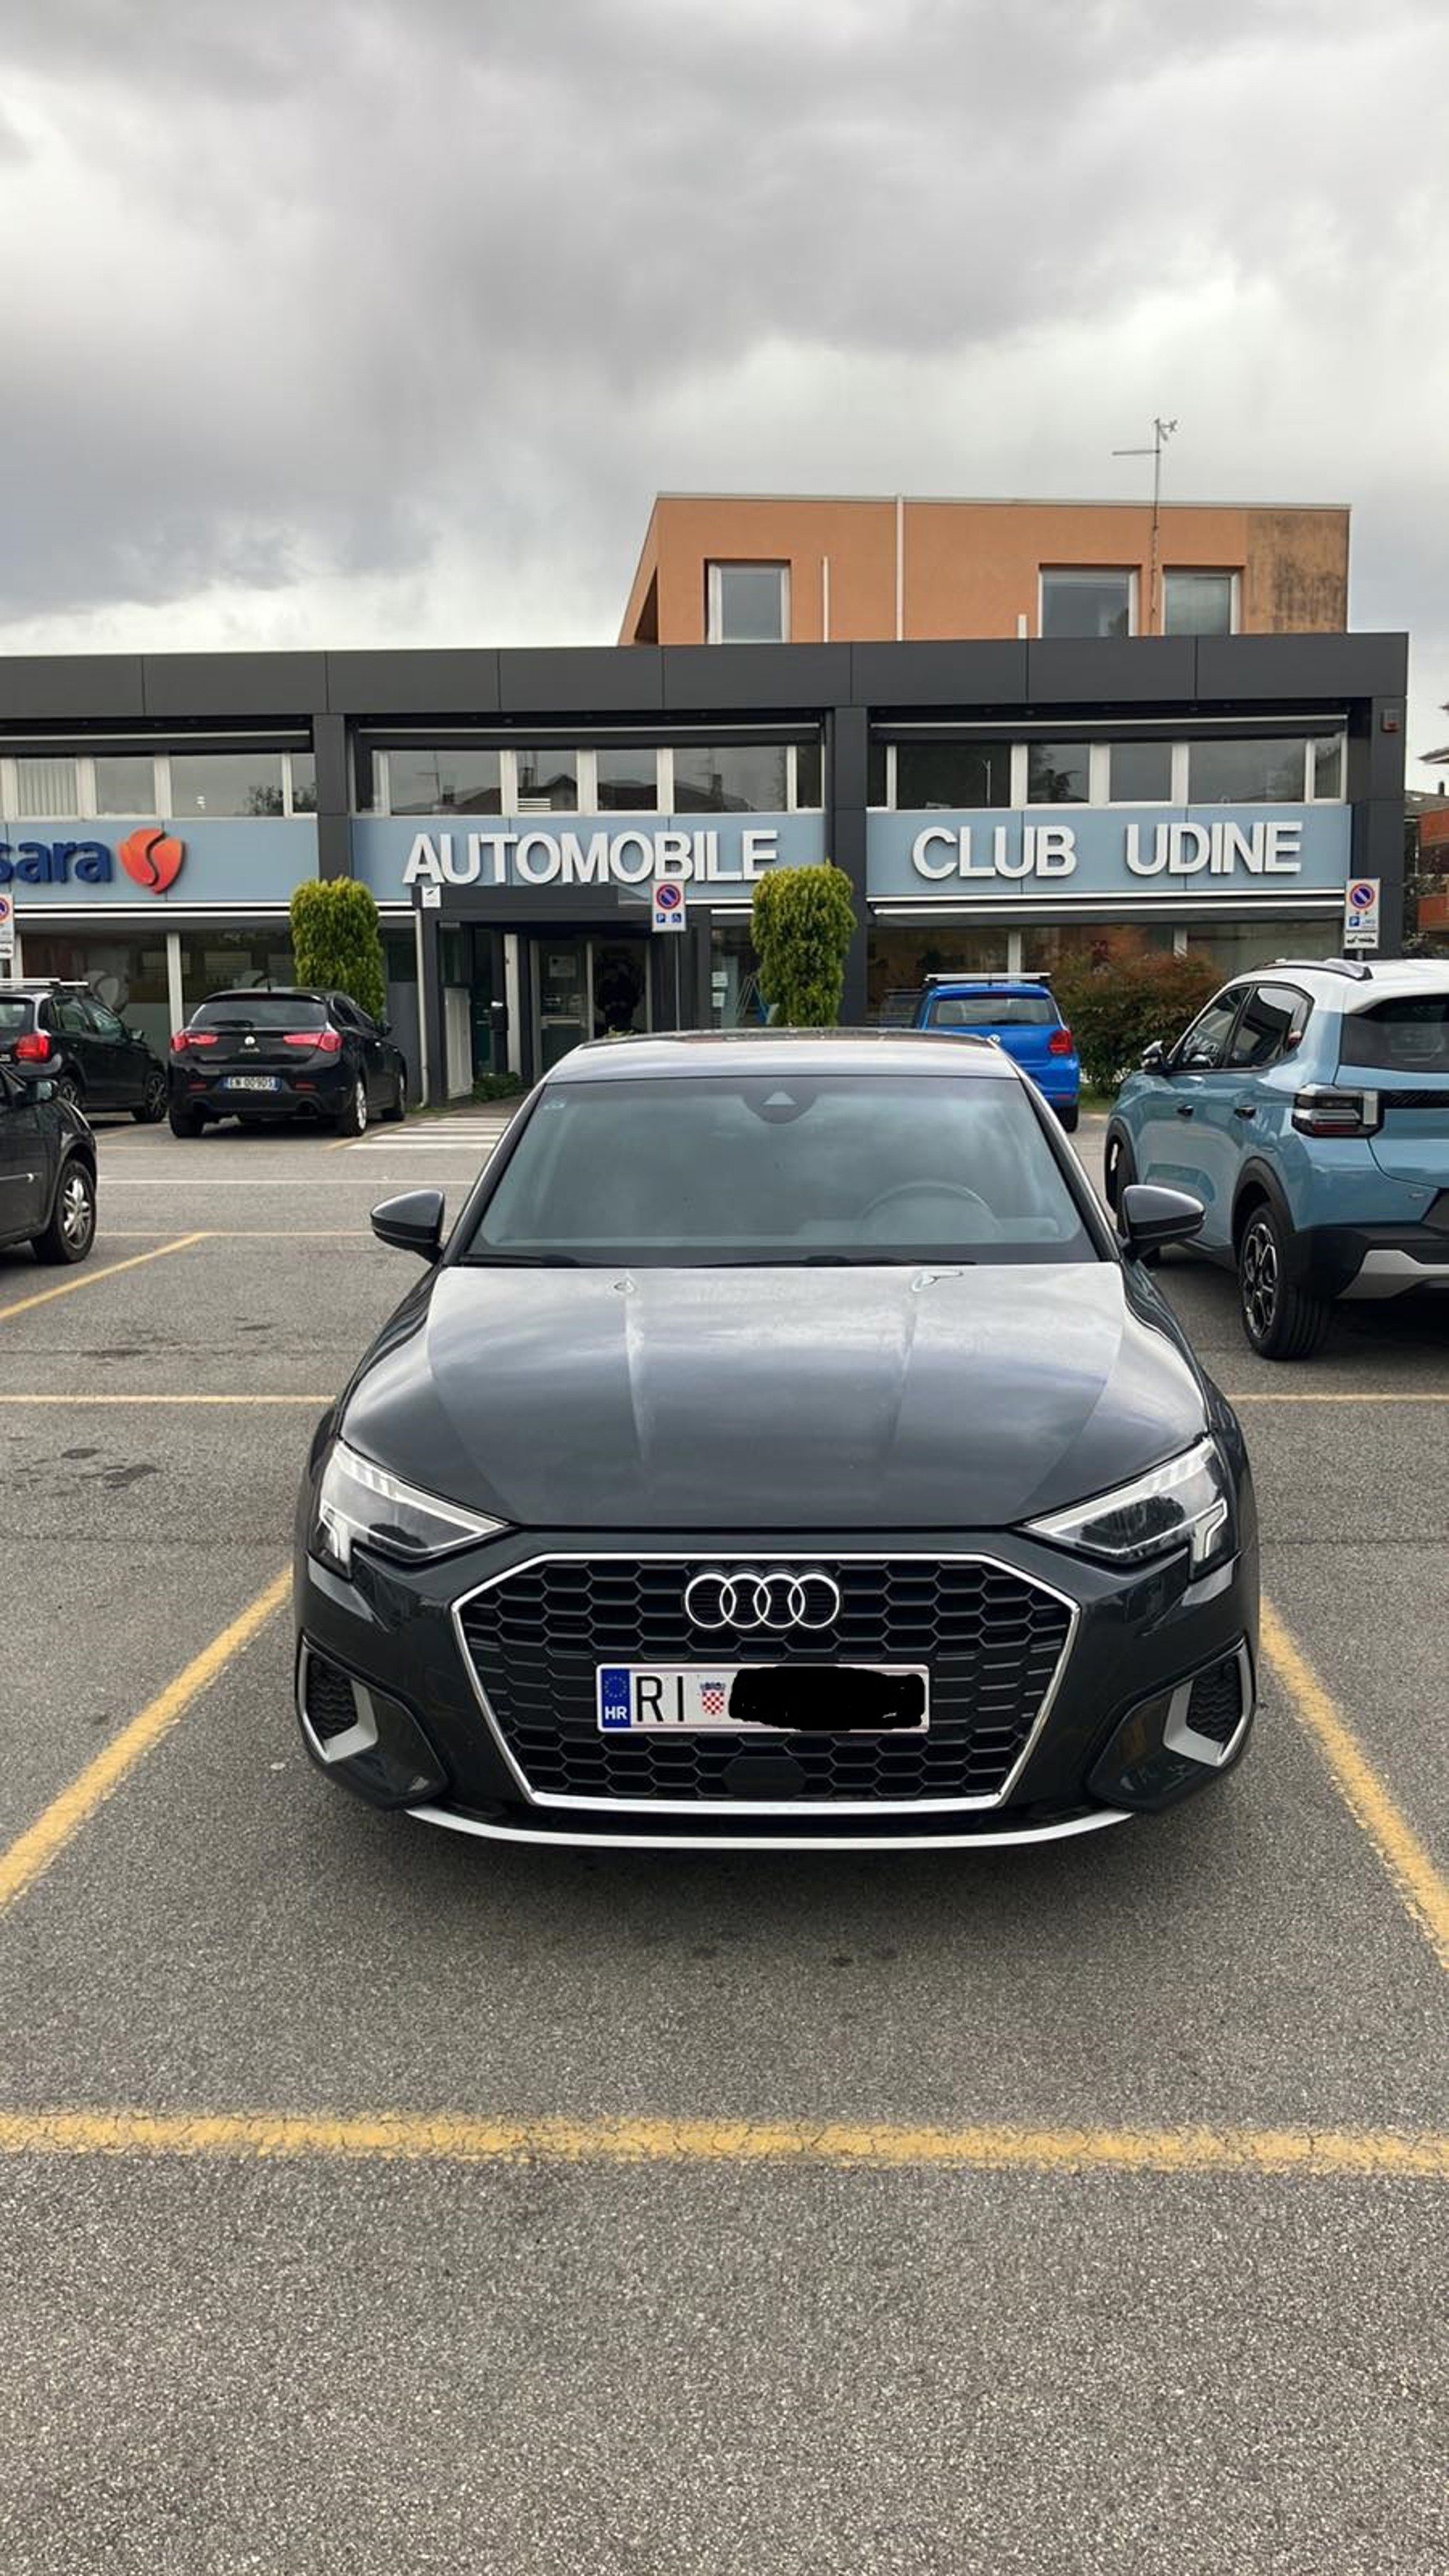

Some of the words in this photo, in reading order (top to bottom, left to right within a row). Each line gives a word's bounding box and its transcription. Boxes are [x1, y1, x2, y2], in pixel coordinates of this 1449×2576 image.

[403, 830, 778, 884] AUTOMOBILE
[912, 825, 1077, 879] CLUB
[1125, 821, 1302, 875] UDINE
[605, 1705, 627, 1720] HR
[636, 1676, 684, 1722] RI
